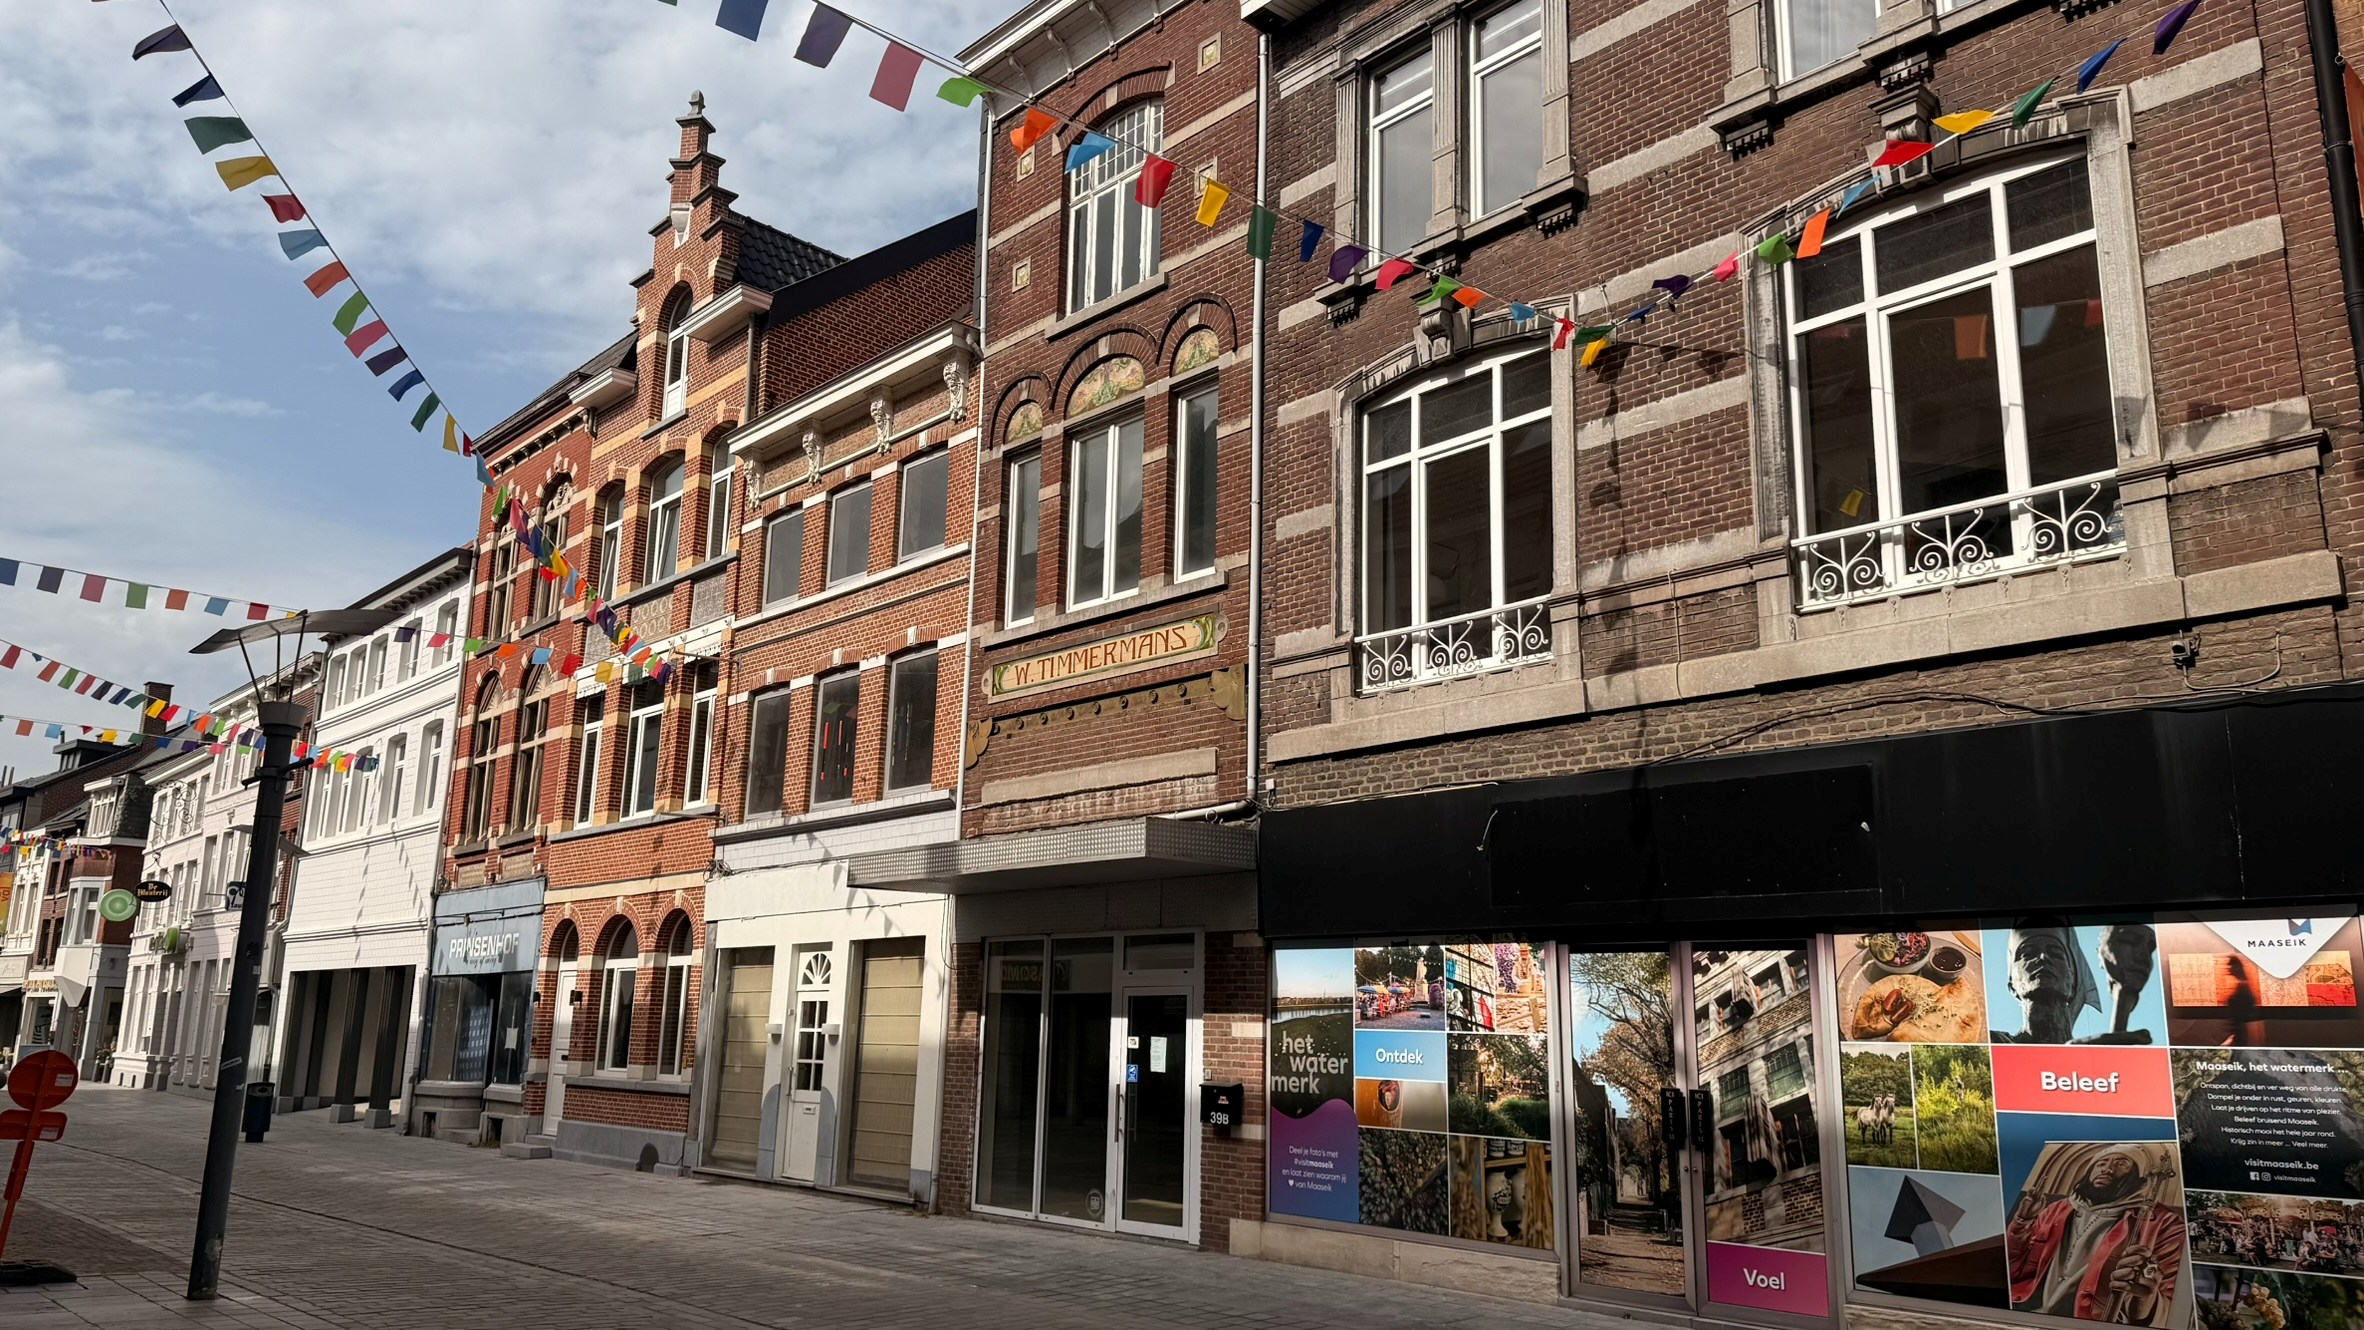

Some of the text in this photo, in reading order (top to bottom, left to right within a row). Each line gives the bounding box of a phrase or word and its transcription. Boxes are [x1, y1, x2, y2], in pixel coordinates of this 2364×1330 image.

[1014, 625, 1187, 686] W. TIMMERMANS
[449, 932, 520, 959] PRINSENHOF
[2247, 938, 2307, 948] MAASEIK
[1282, 1030, 1314, 1054] het
[1375, 1047, 1424, 1065] Ontdek
[1289, 1053, 1349, 1075] water
[2195, 1061, 2247, 1073] Maaseik,
[2248, 1062, 2269, 1072] het
[2270, 1063, 2335, 1073] watermerk
[1271, 1071, 1320, 1095] merk
[2040, 1071, 2120, 1093] Beleef
[2231, 1083, 2256, 1091] dichtbij
[2207, 1093, 2234, 1101] Dompel
[2235, 1105, 2258, 1113] drijven
[1210, 1111, 1230, 1124] 39B
[2221, 1126, 2254, 1134] Historisch
[2317, 1130, 2336, 1138] rond.
[2230, 1137, 2246, 1146] Krijg
[1288, 1145, 1303, 1154] Deel
[1303, 1148, 1309, 1156] je
[1309, 1147, 1326, 1157] foto's
[2244, 1158, 2319, 1170] visitmaaseik.be
[1281, 1168, 1290, 1176] en
[1290, 1168, 1302, 1177] laat
[1303, 1170, 1315, 1178] zien
[1315, 1172, 1341, 1180] waarom
[2273, 1174, 2316, 1183] visitmaaseik
[1295, 1181, 1332, 1192] van Maaseik
[1743, 1267, 1785, 1290] Voel
